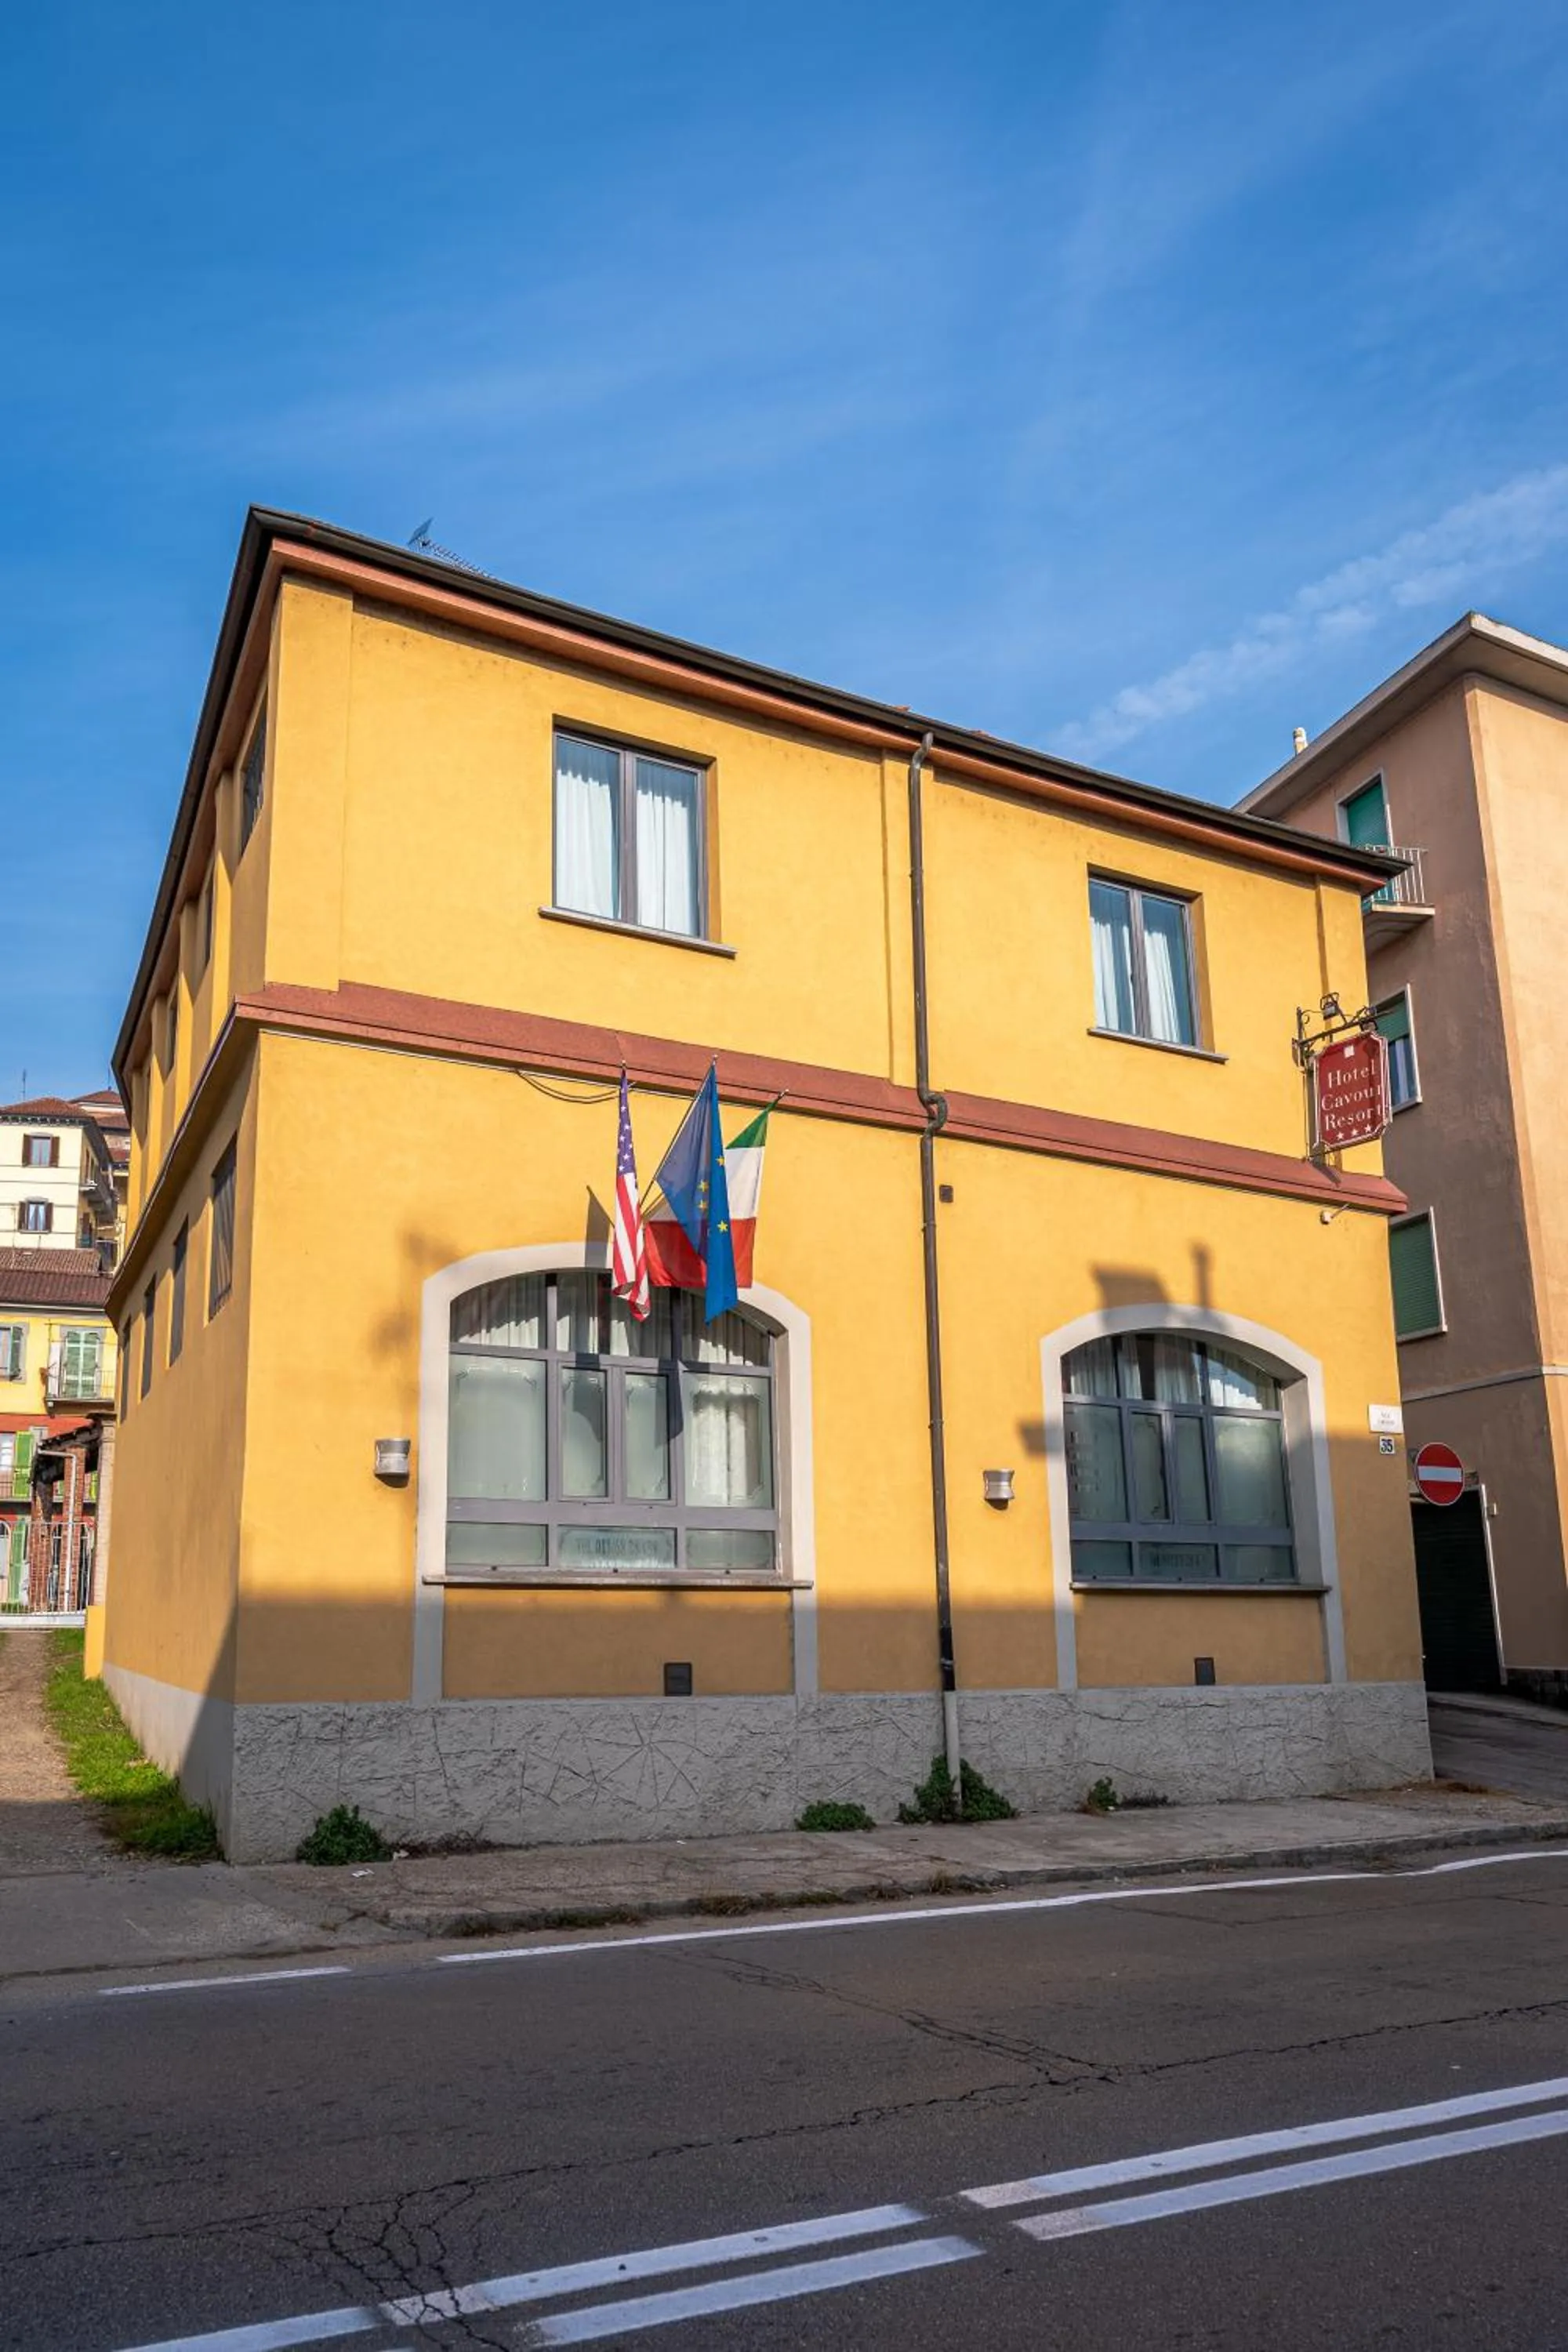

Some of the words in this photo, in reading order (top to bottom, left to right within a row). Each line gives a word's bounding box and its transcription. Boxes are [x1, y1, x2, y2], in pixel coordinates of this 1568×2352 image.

[1328, 1059, 1374, 1088] Hotel
[1322, 1084, 1381, 1110] Cavour
[1325, 1104, 1381, 1131] Resort
[1381, 1438, 1393, 1453] 35
